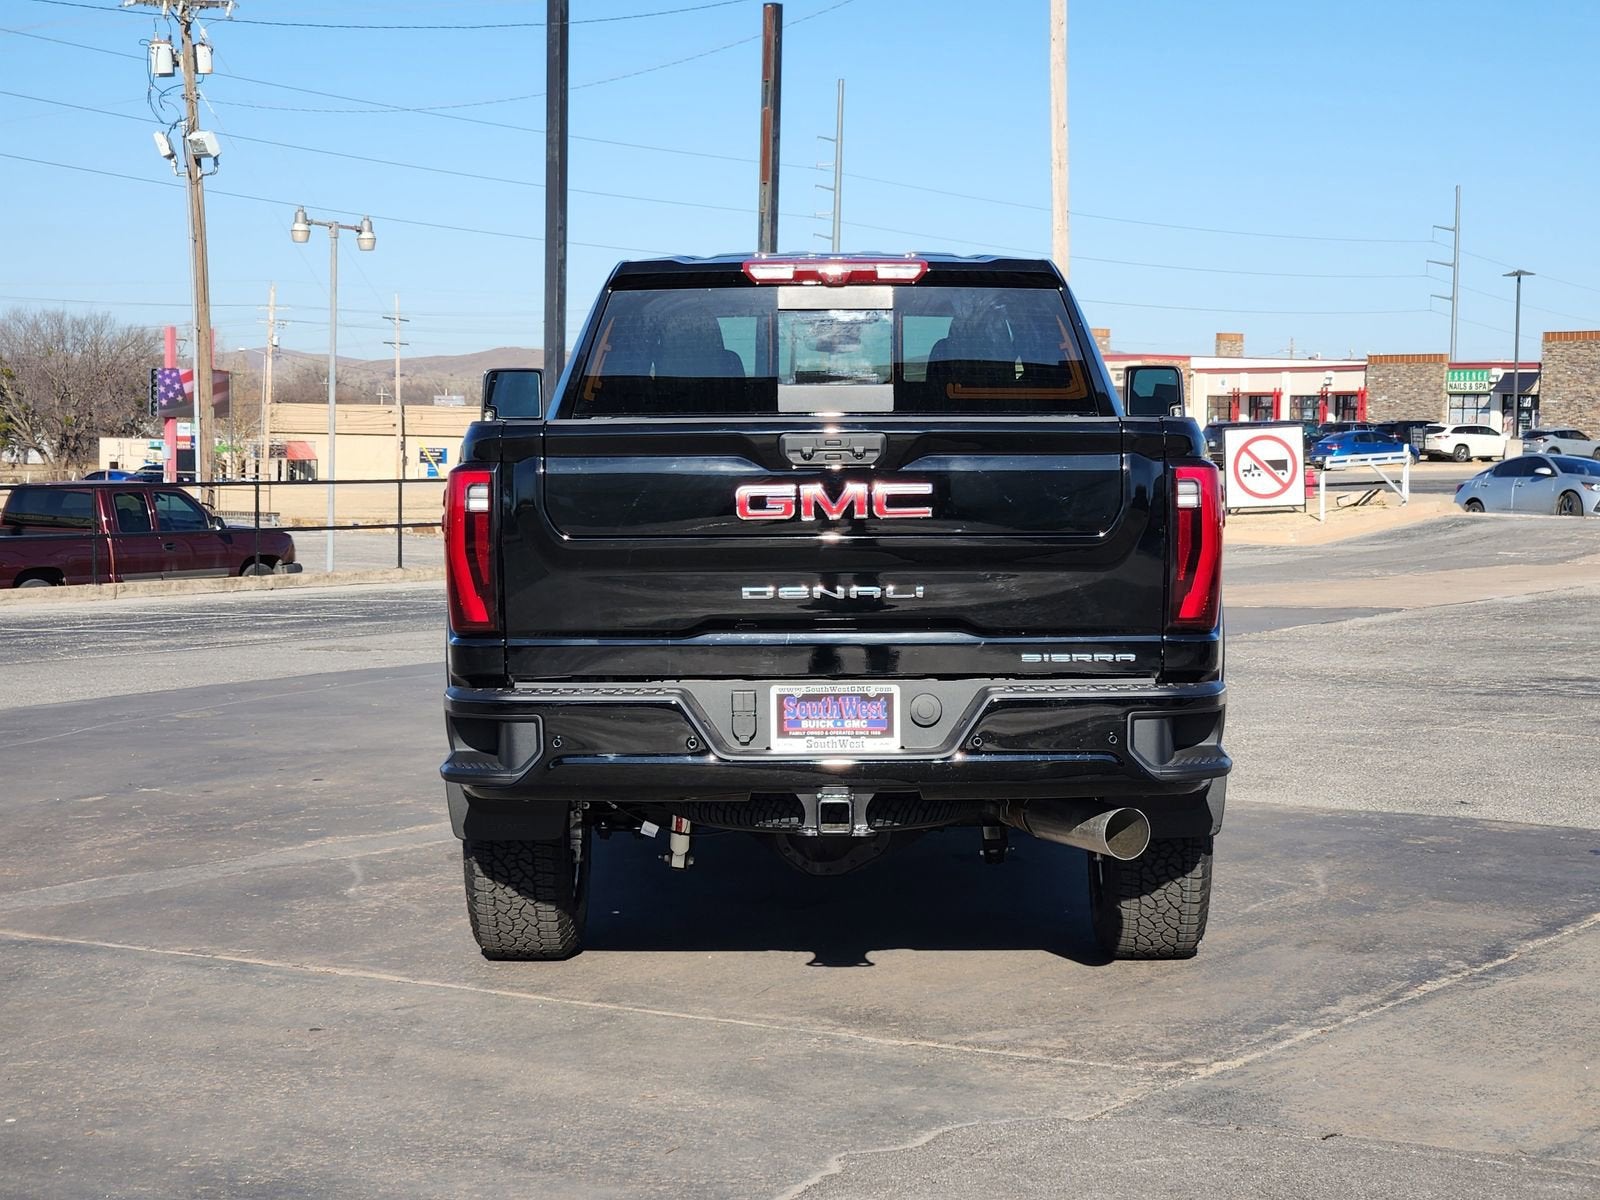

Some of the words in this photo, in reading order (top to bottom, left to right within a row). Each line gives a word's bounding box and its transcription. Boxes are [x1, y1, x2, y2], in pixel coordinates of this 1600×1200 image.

[1448, 371, 1488, 381] ESSENCE
[735, 482, 934, 522] GMC
[741, 586, 925, 600] DENALI
[1021, 653, 1136, 663] SIERRA
[784, 696, 887, 719] SouthWest
[801, 719, 835, 728] BUICK
[844, 719, 868, 728] GMC
[806, 739, 864, 749] SouthWest
